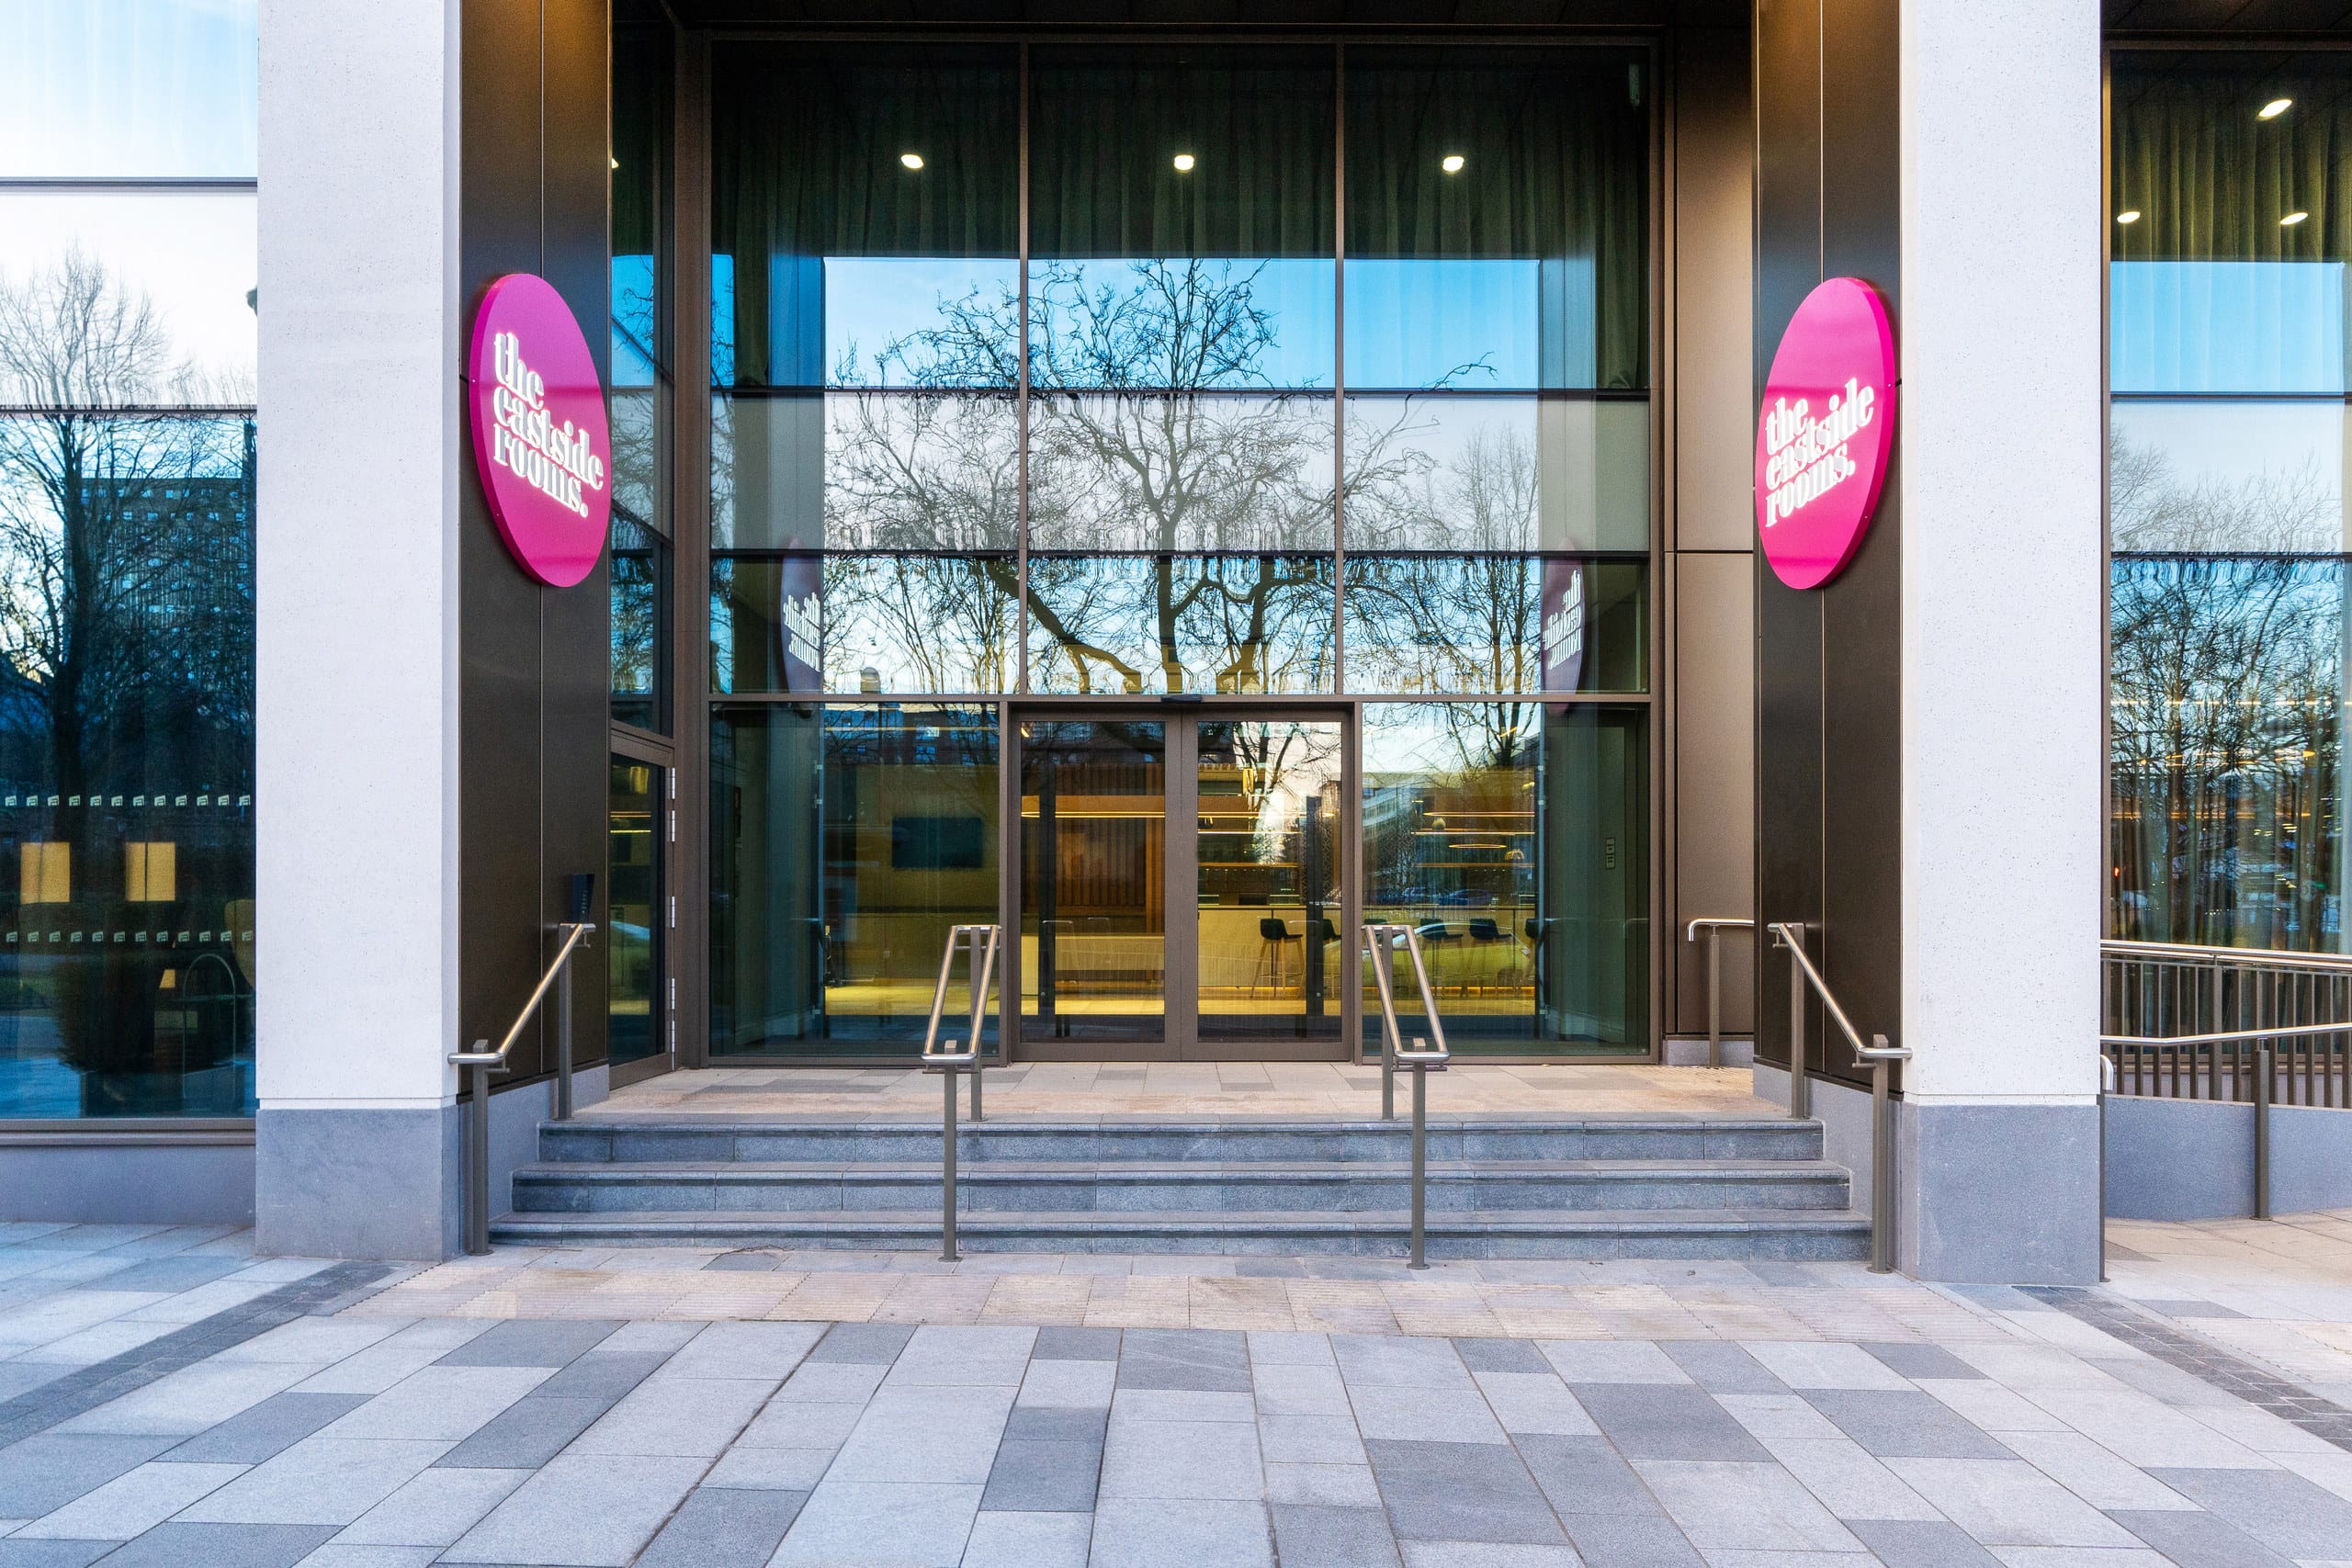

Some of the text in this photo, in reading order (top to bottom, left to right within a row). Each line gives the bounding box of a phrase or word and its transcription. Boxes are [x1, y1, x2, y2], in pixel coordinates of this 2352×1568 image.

[493, 332, 545, 410] the
[493, 385, 604, 491] eastside
[493, 423, 589, 518] rooms.
[1765, 397, 1808, 456] the
[1765, 377, 1874, 491] eastside
[1764, 443, 1856, 527] rooms.
